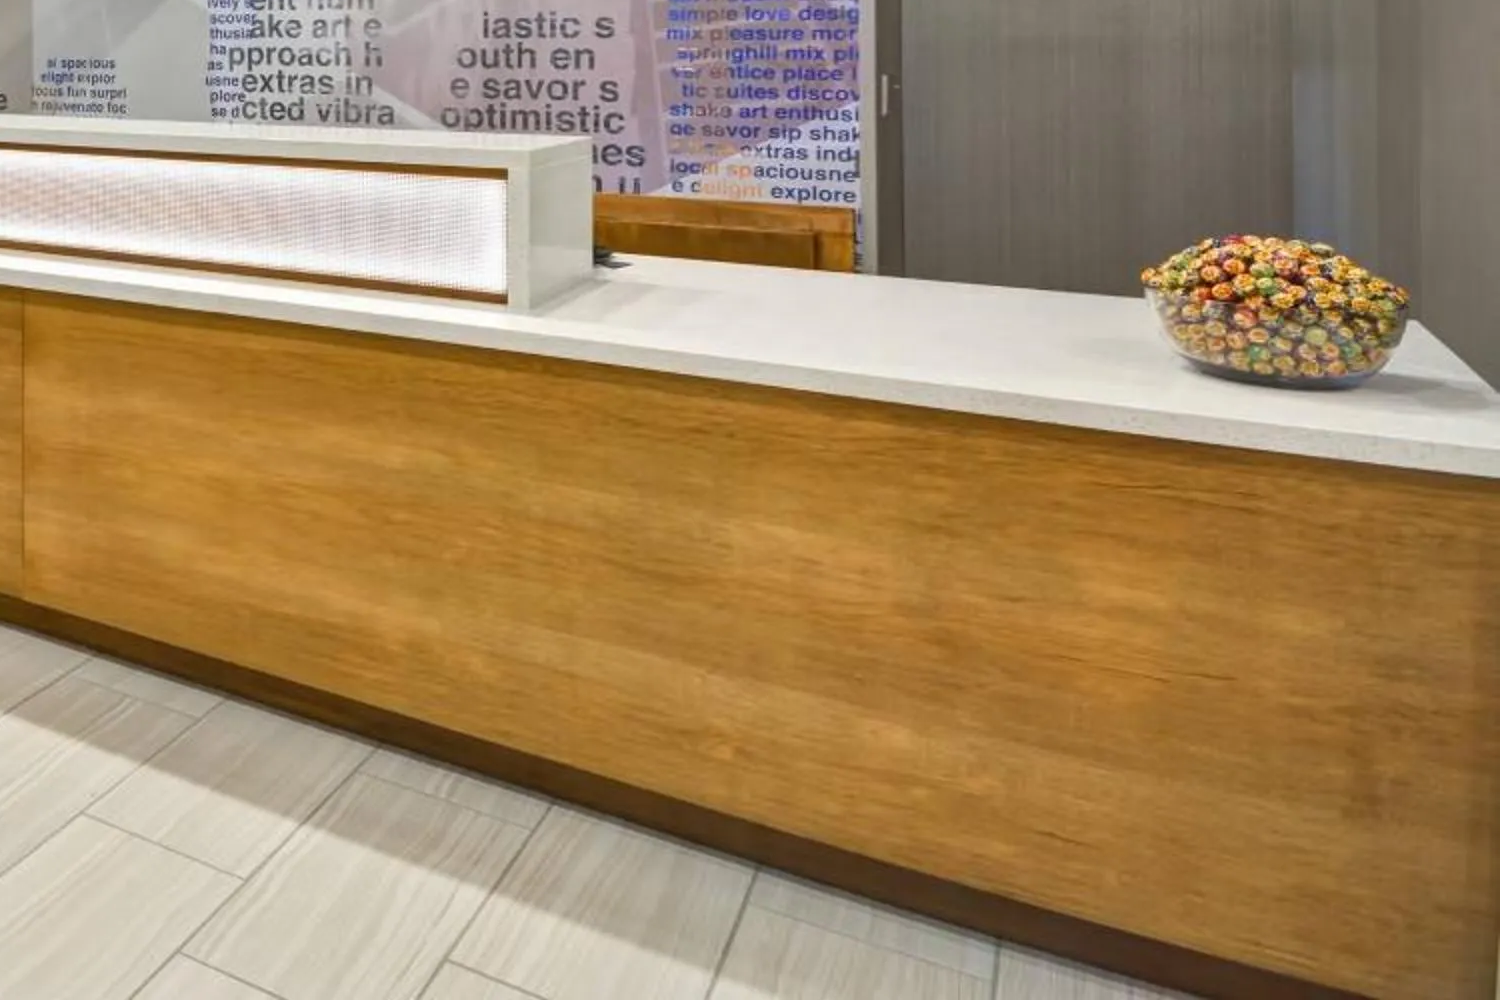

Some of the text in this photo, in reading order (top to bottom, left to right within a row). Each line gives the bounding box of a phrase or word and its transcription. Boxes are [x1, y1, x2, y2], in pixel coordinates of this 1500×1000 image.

[210, 13, 257, 26] scover
[481, 10, 617, 40] iastic s
[667, 3, 859, 25] simple love desig
[253, 14, 383, 39] ake art e
[666, 24, 858, 43] mix pleasure mor
[228, 40, 384, 73] pproach h
[456, 42, 596, 71] outh en
[784, 45, 827, 62] mix
[207, 60, 225, 72] as
[709, 65, 776, 82] entice
[782, 67, 845, 84] place
[66, 85, 88, 99] fun
[241, 69, 375, 97] extras in
[449, 76, 621, 103] e savor s
[682, 82, 860, 103] tic suites discov
[209, 89, 247, 104] plore
[242, 96, 397, 127] cted vibra
[439, 102, 627, 136] optimistic
[668, 101, 733, 119] shake
[738, 103, 768, 120] art
[701, 124, 761, 140] savor
[768, 122, 802, 145] sip
[739, 142, 809, 162] extras
[671, 180, 684, 194] e
[770, 183, 858, 205] explore
